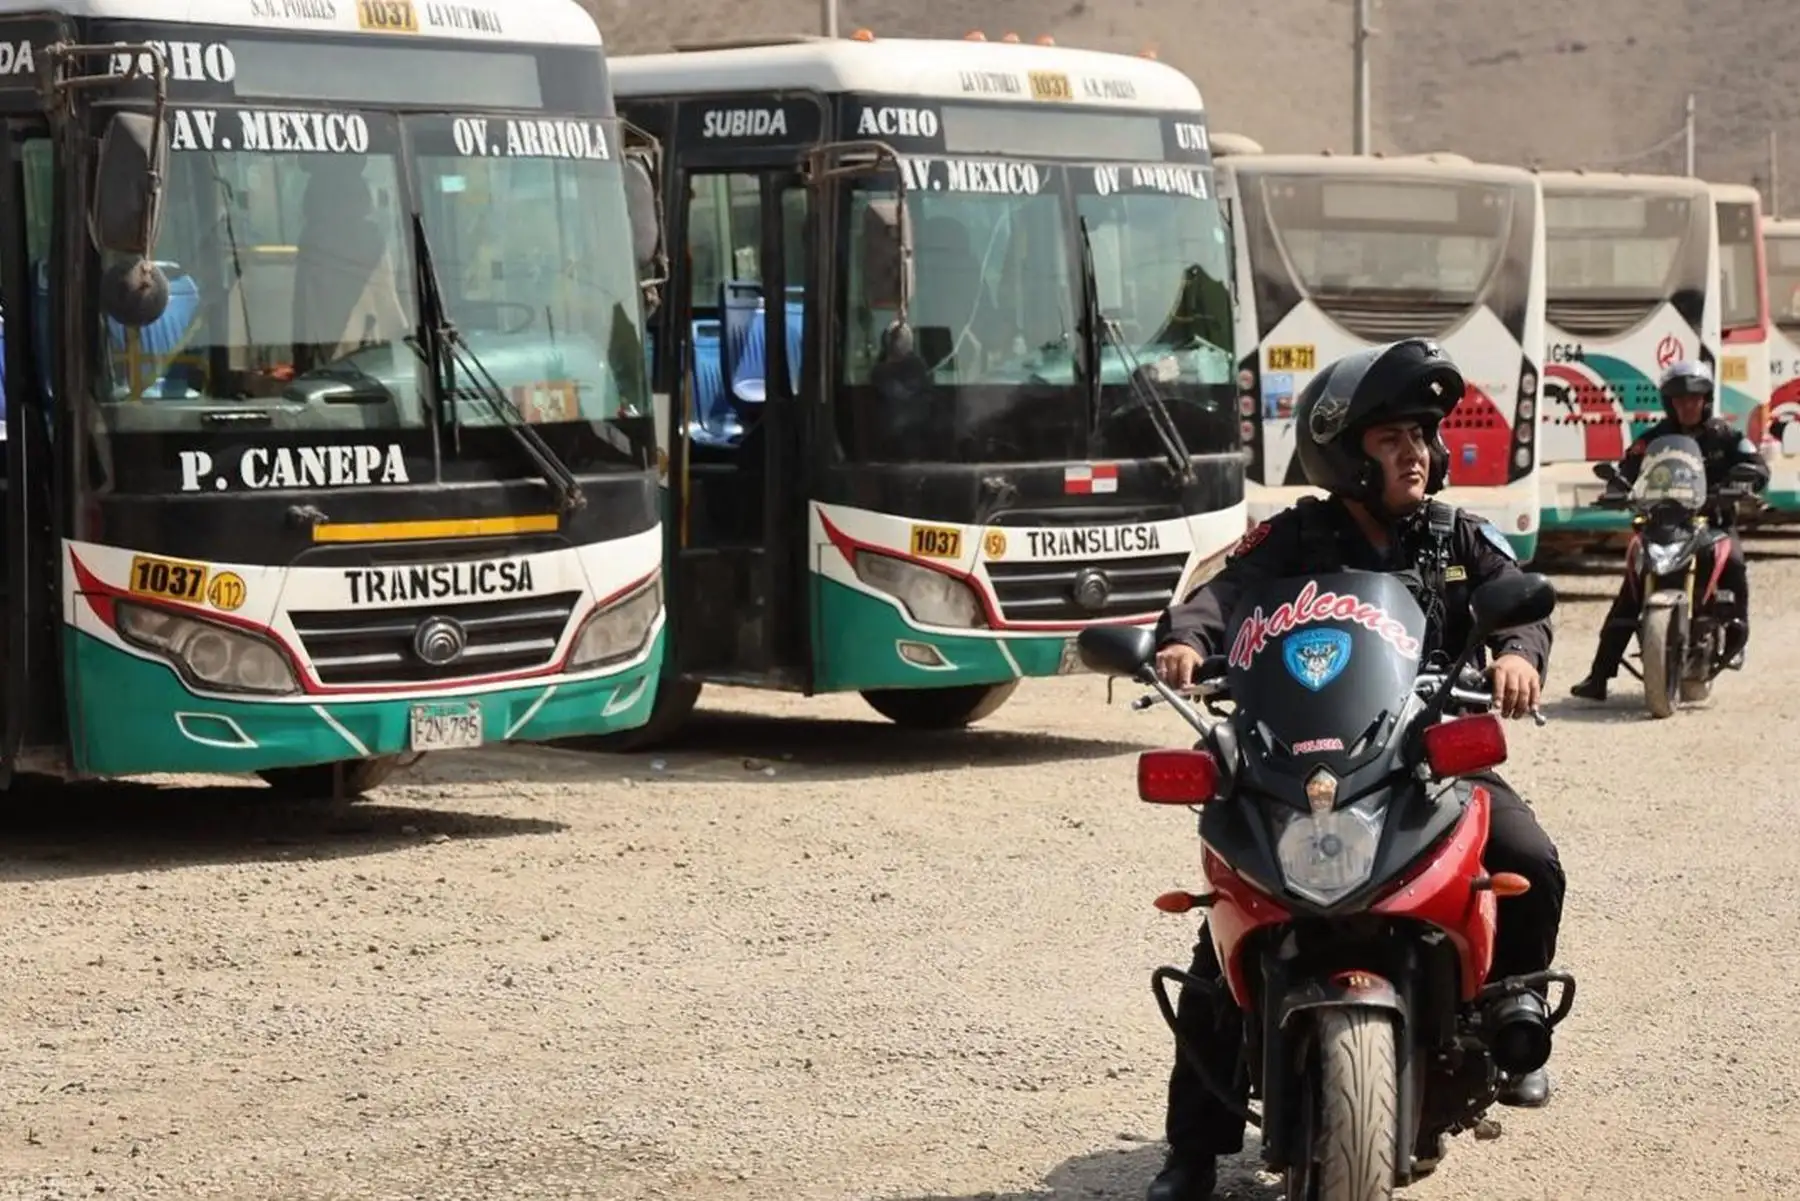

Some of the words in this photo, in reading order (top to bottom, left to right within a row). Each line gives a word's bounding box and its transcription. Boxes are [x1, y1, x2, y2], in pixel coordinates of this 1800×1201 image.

[362, 0, 413, 27] 1037
[426, 2, 445, 27] LA
[444, 4, 503, 34] VICTORIA
[1032, 73, 1069, 97] 1037
[171, 110, 232, 150] AV.
[238, 110, 369, 154] MEXICO
[703, 109, 787, 137] SUBIDA
[857, 107, 938, 137] ACHO
[452, 118, 500, 157] OV.
[506, 120, 610, 161] ARRIOLA
[946, 160, 1039, 195] MEXICO
[179, 451, 228, 491] P.
[240, 444, 410, 488] CANEPA
[915, 529, 959, 556] 1037
[1027, 526, 1161, 557] TRANSLICSA
[136, 561, 202, 598] 1037
[344, 560, 534, 605] TRANSLICSA
